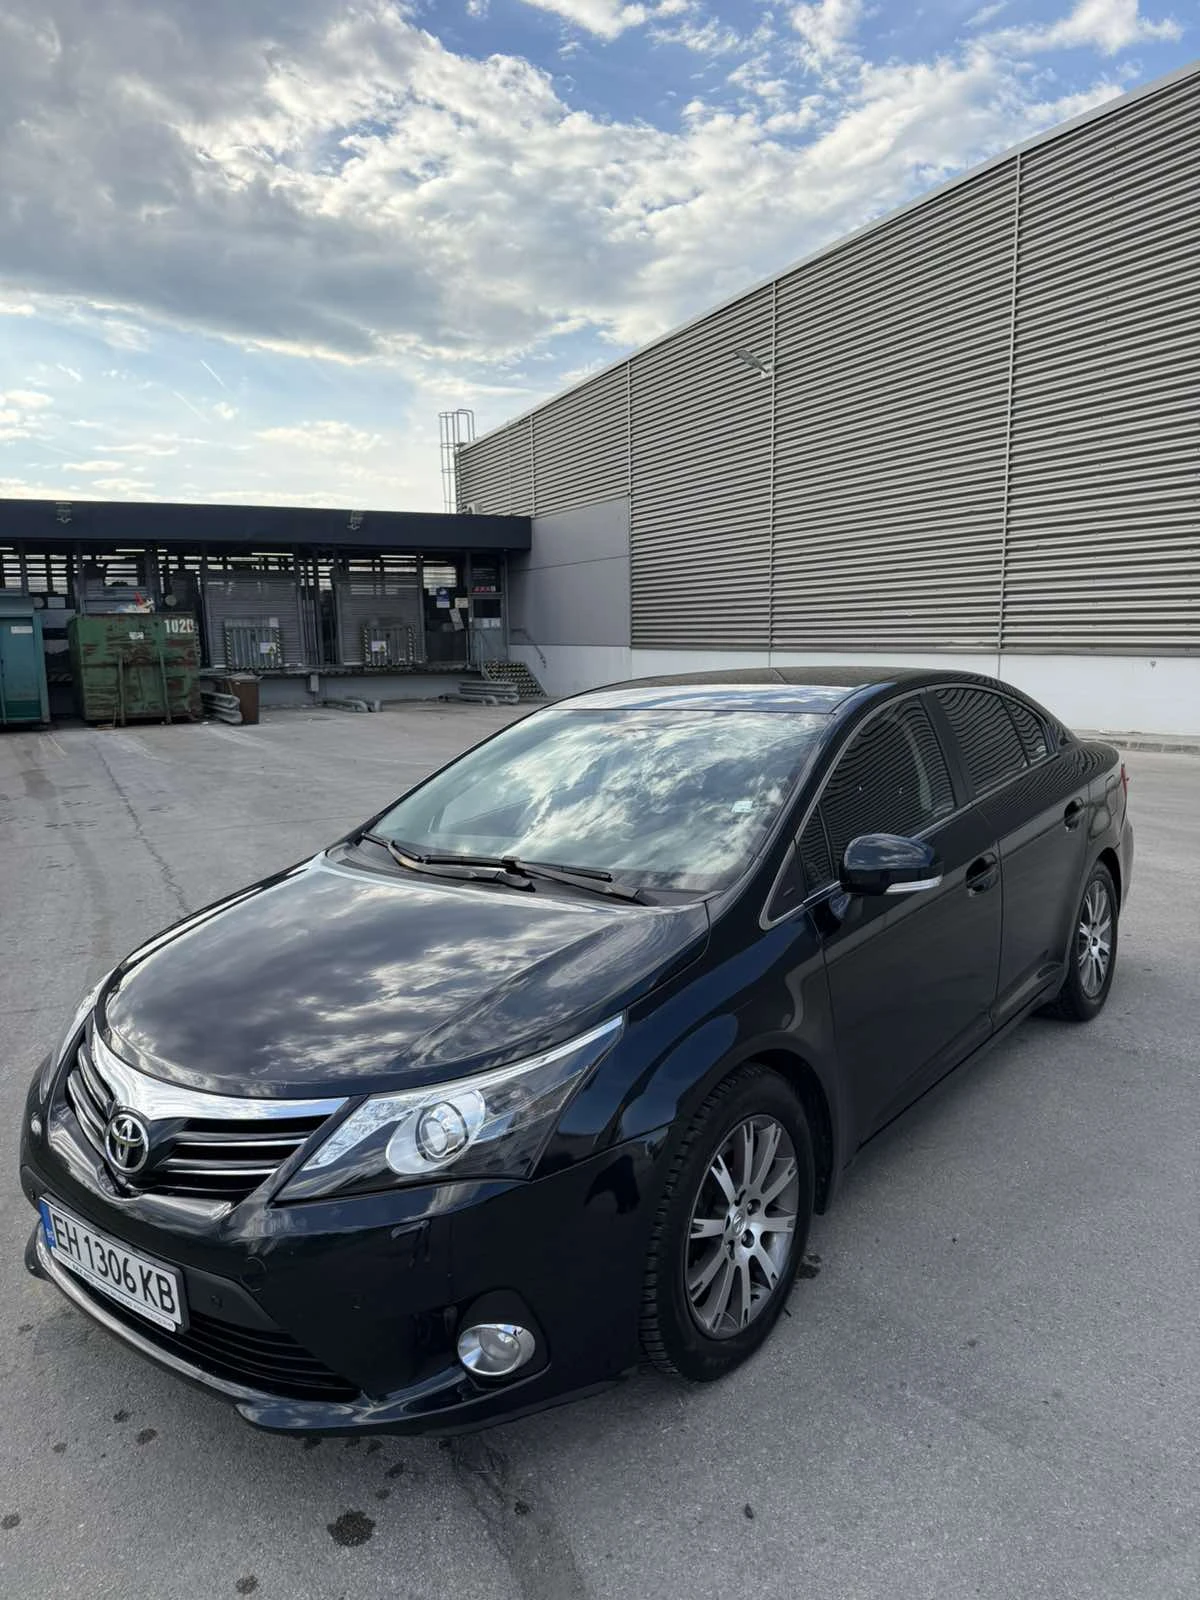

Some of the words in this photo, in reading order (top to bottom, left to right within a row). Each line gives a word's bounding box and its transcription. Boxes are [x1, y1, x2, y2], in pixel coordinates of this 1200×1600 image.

[52, 1213, 82, 1261] EH
[83, 1235, 137, 1294] 1306
[139, 1265, 176, 1314] KB
